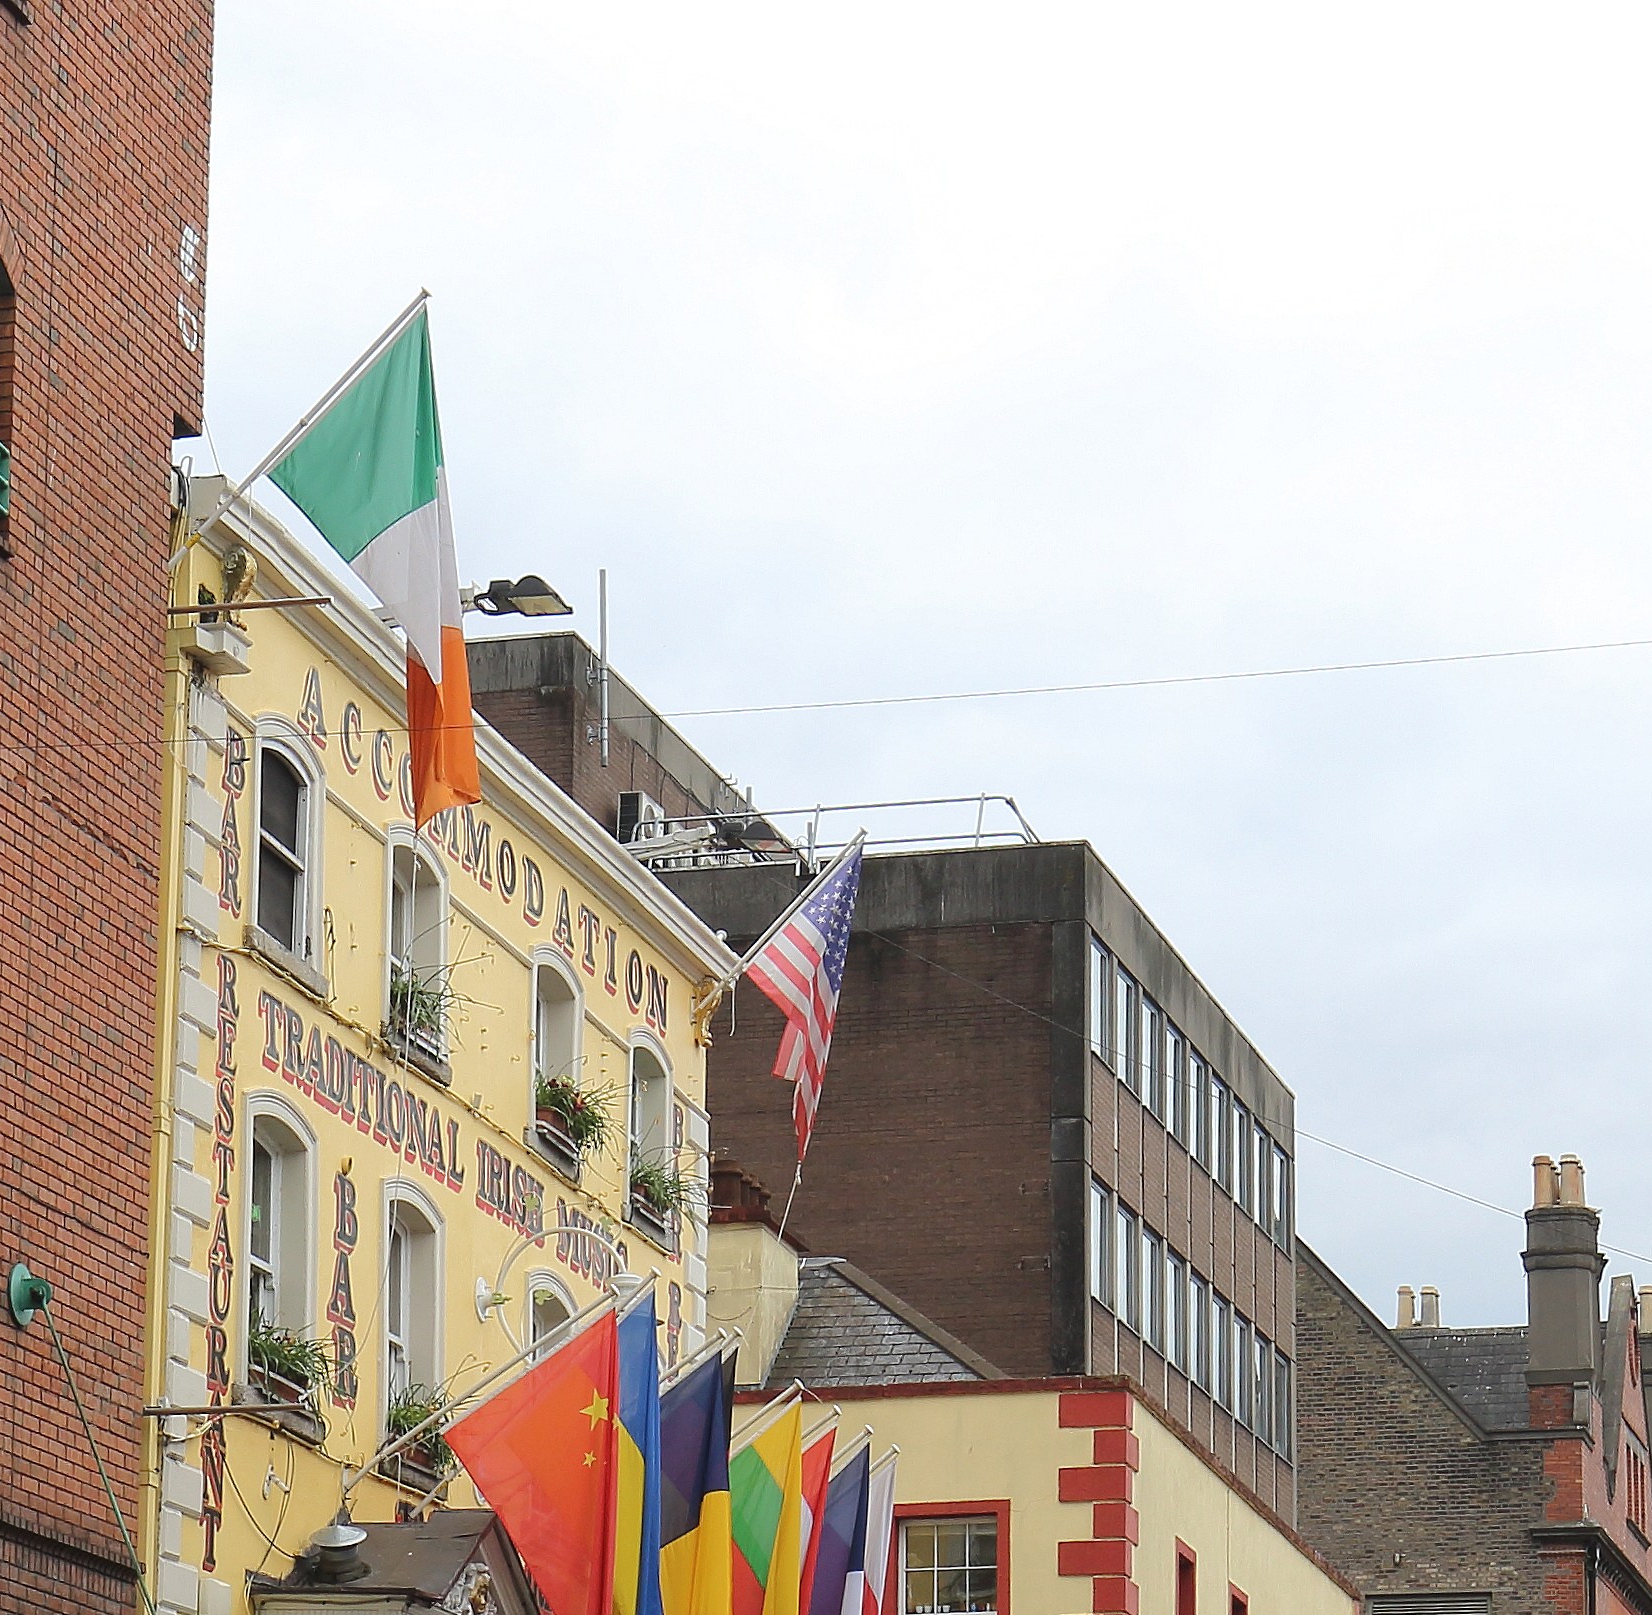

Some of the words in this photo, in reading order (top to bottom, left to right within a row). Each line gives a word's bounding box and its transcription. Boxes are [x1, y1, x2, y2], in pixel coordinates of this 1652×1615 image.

[219, 725, 247, 919] BAR
[298, 666, 670, 1038] ACCOMMODATION
[259, 990, 467, 1194] TRADITIONAL
[476, 1138, 547, 1249] IRISH
[200, 951, 240, 1573] RESTAURANT
[326, 1170, 359, 1409] BAR
